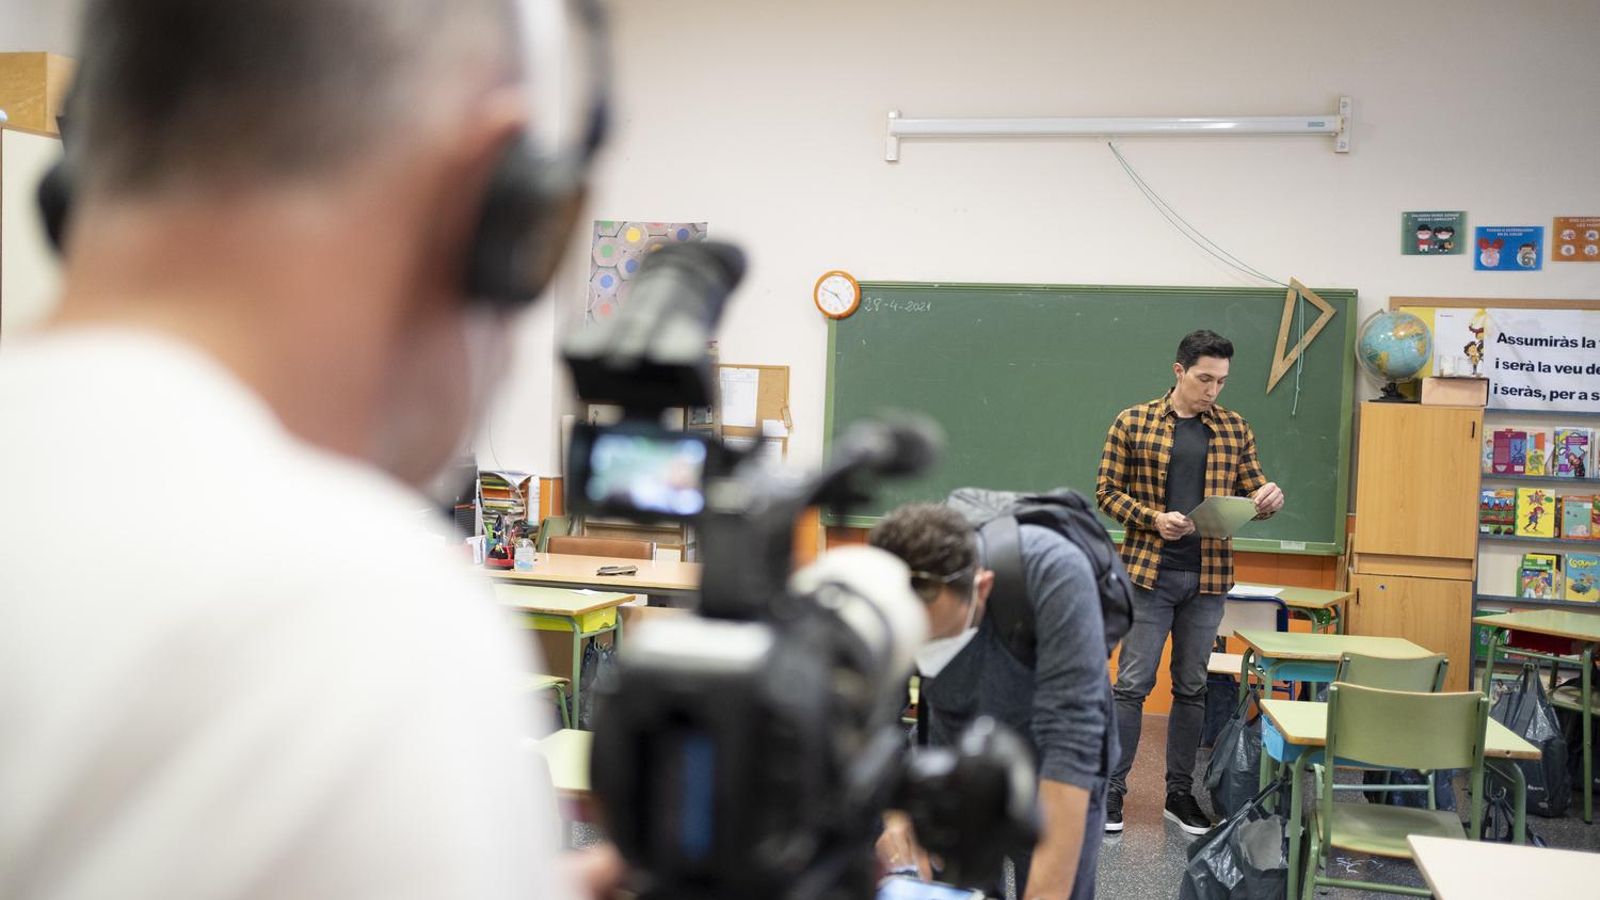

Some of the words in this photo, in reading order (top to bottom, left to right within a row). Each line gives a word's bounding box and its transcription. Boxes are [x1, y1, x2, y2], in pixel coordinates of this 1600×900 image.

[864, 297, 932, 312] 28-4-2021
[1497, 332, 1579, 348] Assumiràs
[1581, 336, 1596, 349] la
[1495, 358, 1499, 369] i
[1502, 360, 1535, 372] serà
[1538, 361, 1551, 373] la
[1554, 364, 1582, 375] veu
[1493, 383, 1498, 395] i
[1500, 385, 1546, 401] seràs,
[1549, 389, 1576, 402] per
[1578, 390, 1588, 401] a
